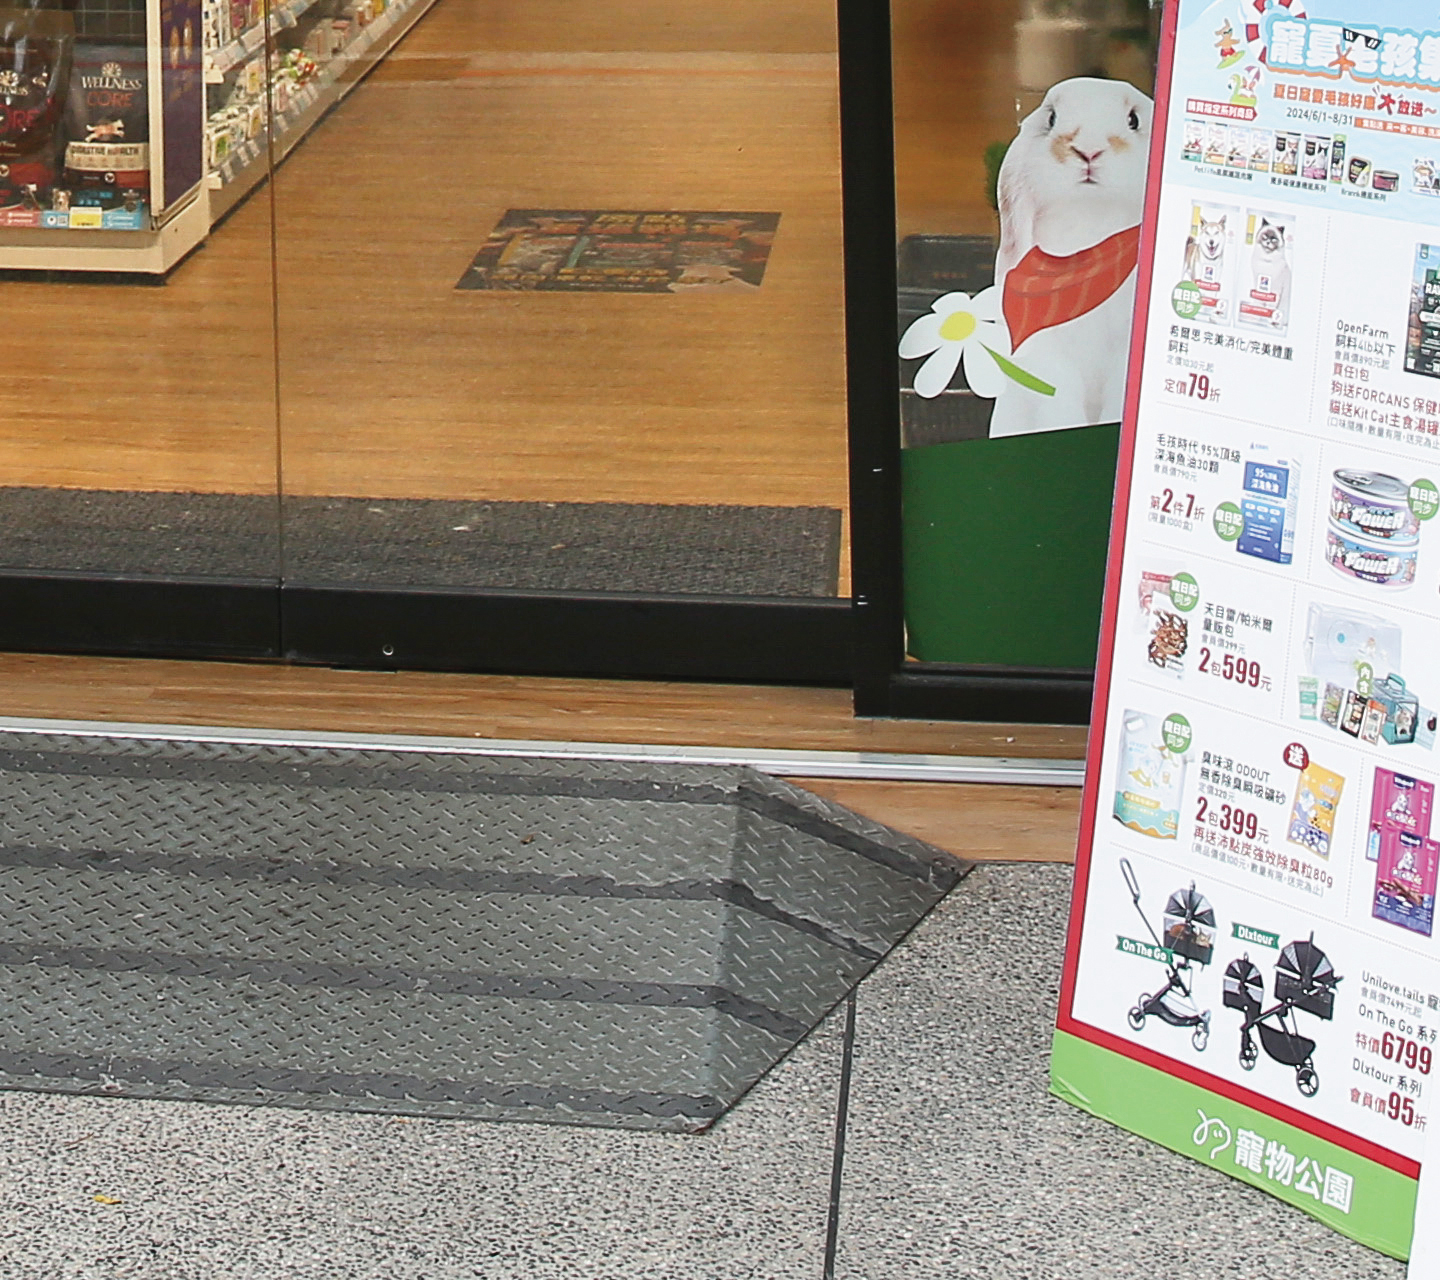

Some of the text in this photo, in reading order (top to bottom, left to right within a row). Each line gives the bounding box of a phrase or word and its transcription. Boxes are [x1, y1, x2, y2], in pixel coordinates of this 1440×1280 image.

[81, 75, 143, 90] WELLNESS
[87, 90, 133, 108] CORE
[1170, 324, 1201, 342] 希爾思
[1336, 319, 1389, 339] OpenFarm
[1168, 340, 1189, 355] 飼料
[1335, 333, 1396, 358] 飼料4lb以下
[1333, 362, 1370, 382] 買任1包
[1163, 372, 1221, 403] 定價79折
[1330, 380, 1411, 410] 狗送FORCANS
[1329, 399, 1369, 422] 貓送Kit
[1156, 432, 1242, 464] 毛孩時代 95%頂級
[1154, 447, 1220, 475] 深海魚油30顆
[1150, 487, 1206, 523] 第2件7折
[1203, 617, 1235, 638] 量販包
[1198, 646, 1272, 692] 2包599元
[1287, 744, 1305, 766] 送
[1236, 763, 1271, 784] ODOUT
[1195, 795, 1270, 845] 2包399元
[1122, 938, 1168, 962] On The Go
[1358, 1002, 1374, 1020] On
[1376, 1009, 1396, 1028] The
[1398, 1019, 1413, 1036] Go
[1355, 1030, 1433, 1075] 特價6799
[1349, 1086, 1428, 1133] 會員價95折
[1233, 1128, 1355, 1215] 寵物公園
